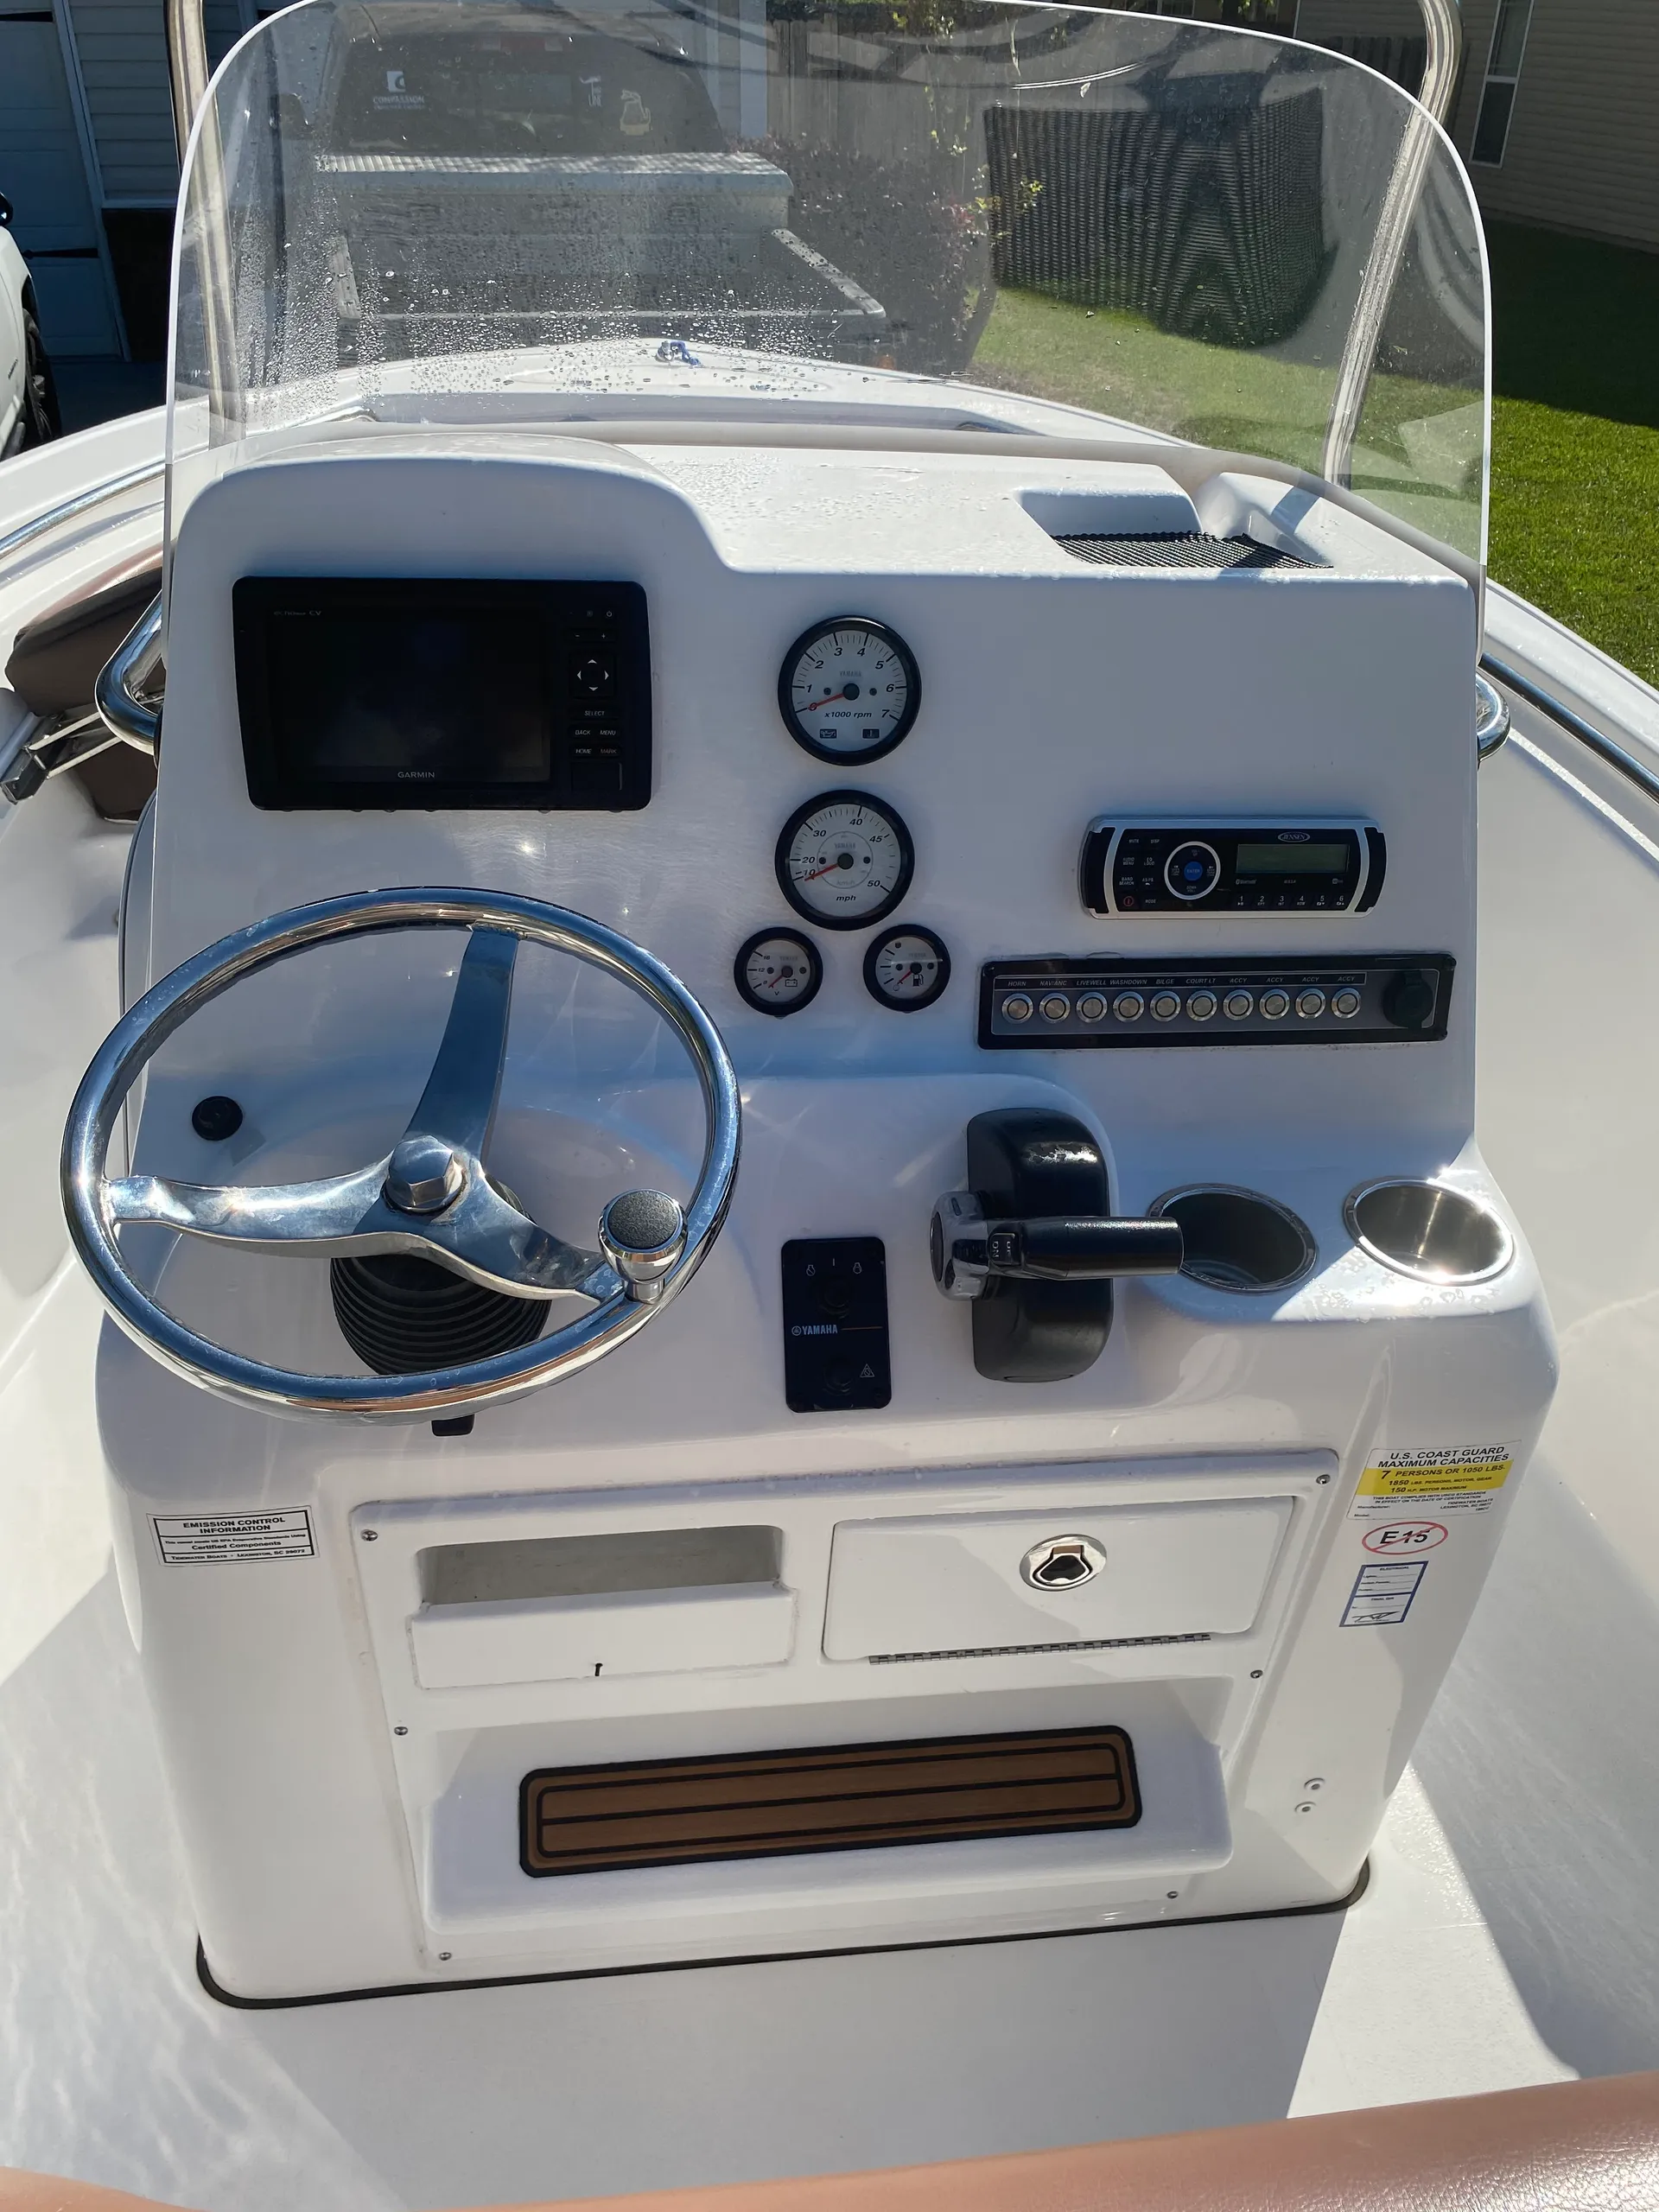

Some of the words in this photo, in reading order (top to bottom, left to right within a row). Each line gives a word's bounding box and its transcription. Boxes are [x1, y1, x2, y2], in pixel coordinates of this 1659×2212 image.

[834, 647, 842, 657] 3
[856, 647, 866, 657] 4
[815, 660, 824, 669] 2
[875, 660, 885, 670] 5
[886, 683, 894, 692] 6
[881, 709, 890, 718] 7
[802, 1325, 838, 1335] YAMAHA
[1461, 1446, 1504, 1456] GUARD
[1440, 1453, 1510, 1465] CAPACITIES
[1381, 1471, 1390, 1479] 7
[200, 1525, 271, 1534] INFORMATION
[1380, 1530, 1430, 1544] E15
